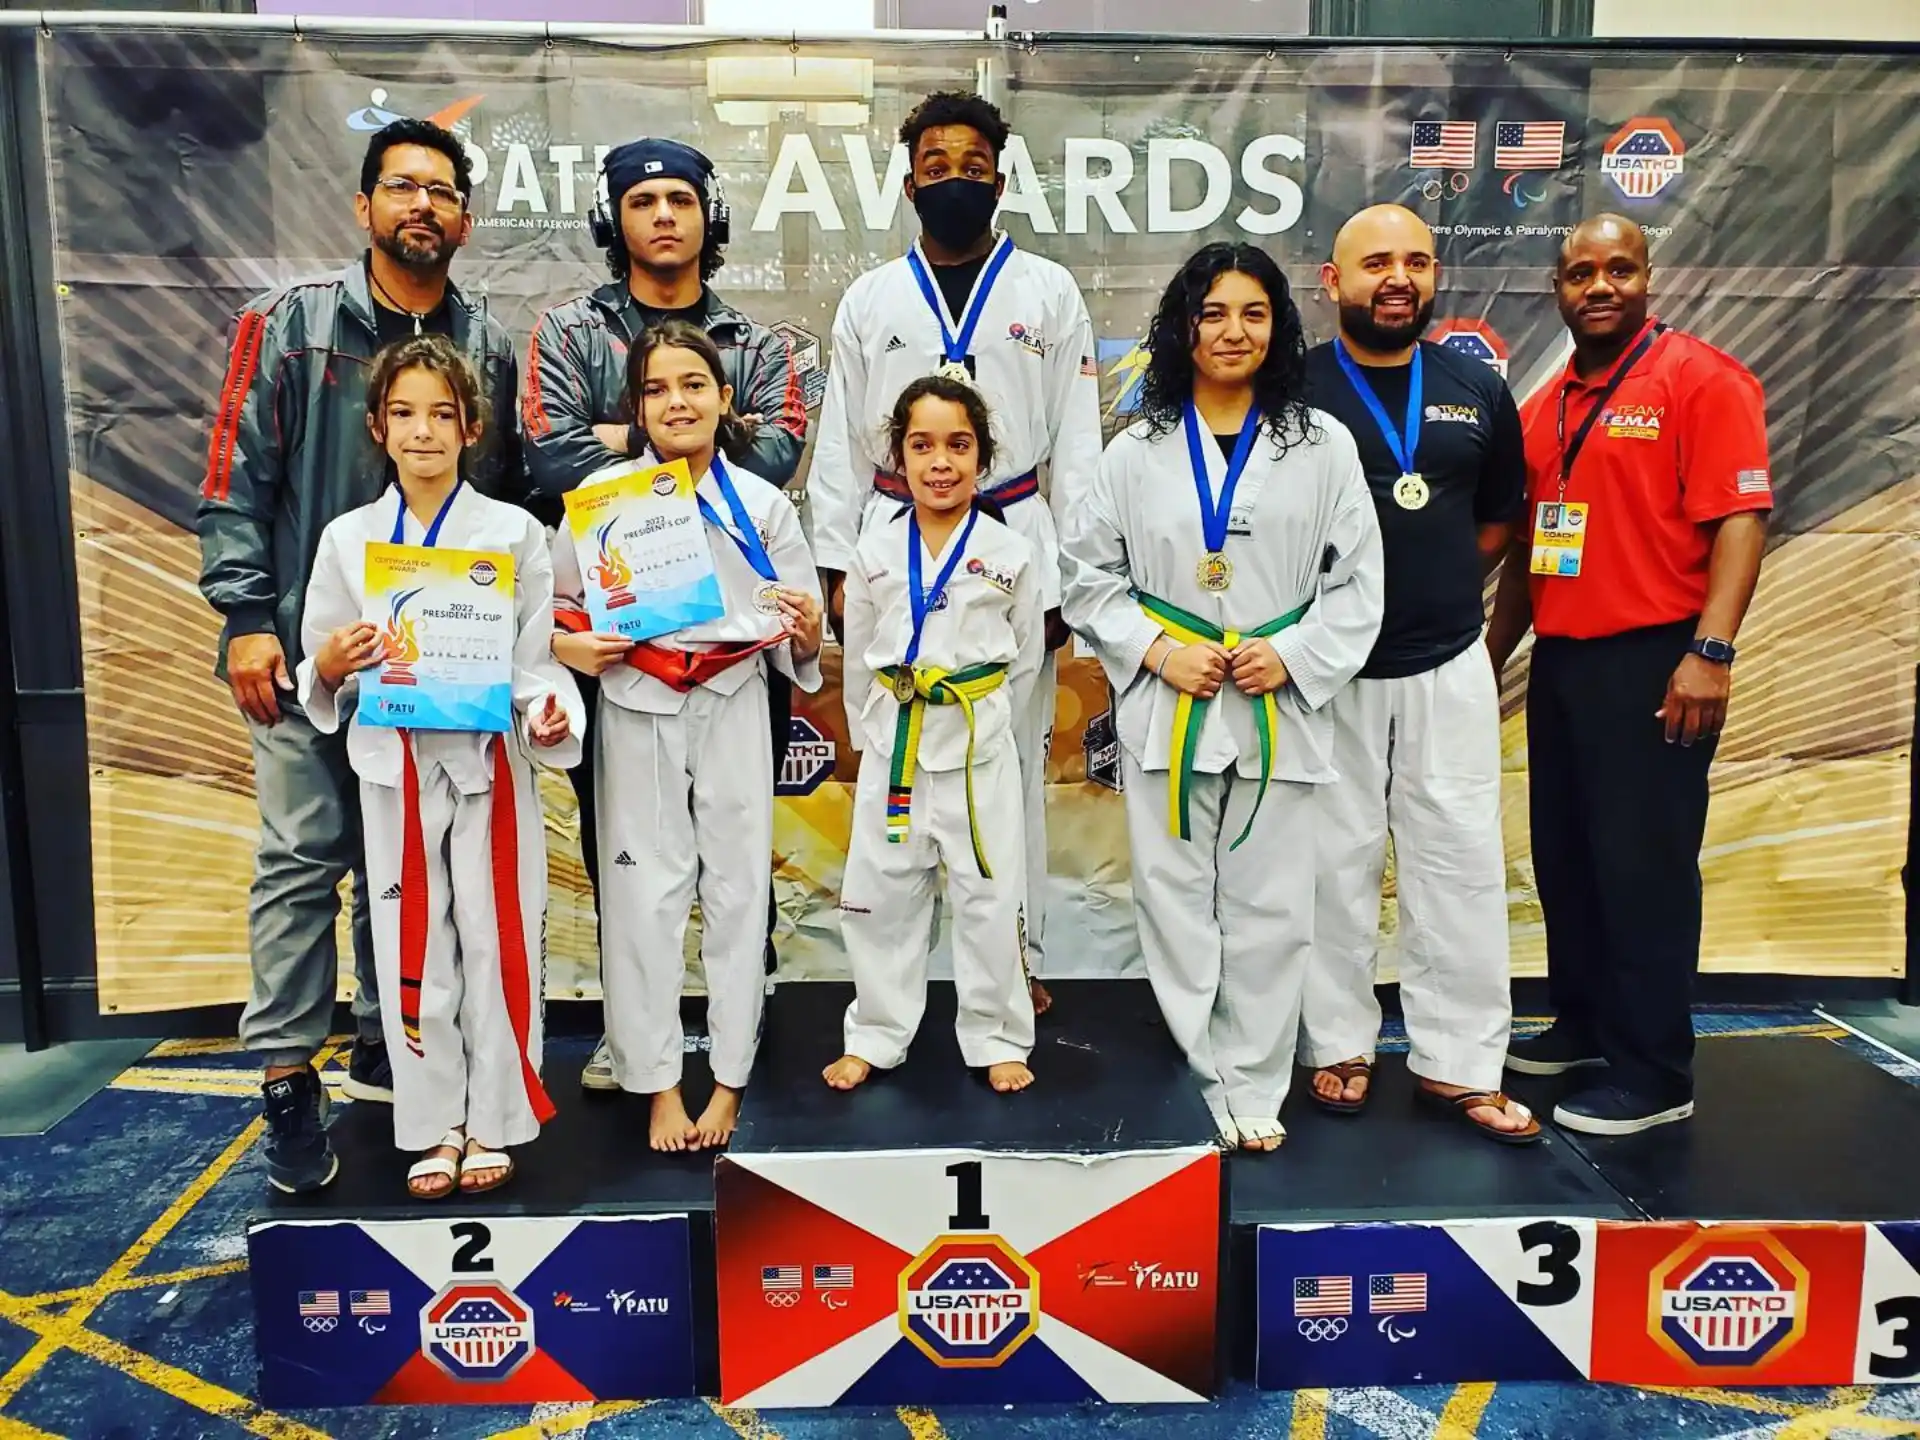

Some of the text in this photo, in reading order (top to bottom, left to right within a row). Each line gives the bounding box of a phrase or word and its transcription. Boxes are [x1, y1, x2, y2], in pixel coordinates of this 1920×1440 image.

[477, 218, 534, 228] AMERICAN
[537, 219, 590, 230] TAEKWON
[1427, 224, 1451, 235] here
[1454, 224, 1501, 237] Olympic
[1504, 226, 1513, 236] &
[1438, 404, 1478, 416] TEAM
[1617, 404, 1665, 418] TEAM
[674, 515, 691, 526] CUP
[1544, 531, 1575, 540] COACH
[449, 603, 474, 612] 2022
[422, 608, 502, 622] PRESIDENT'S CUP
[618, 619, 641, 633] PATU
[387, 703, 415, 713] PATU
[945, 1161, 990, 1230] 1
[449, 1221, 494, 1272] 2
[1516, 1220, 1582, 1307] 3
[1151, 1272, 1199, 1288] PATU
[626, 1298, 669, 1313] PATU
[915, 1294, 1022, 1308] USATKD
[1671, 1296, 1786, 1312] USATKD
[435, 1326, 521, 1338] USATKD
[1868, 1295, 1920, 1379] 3
